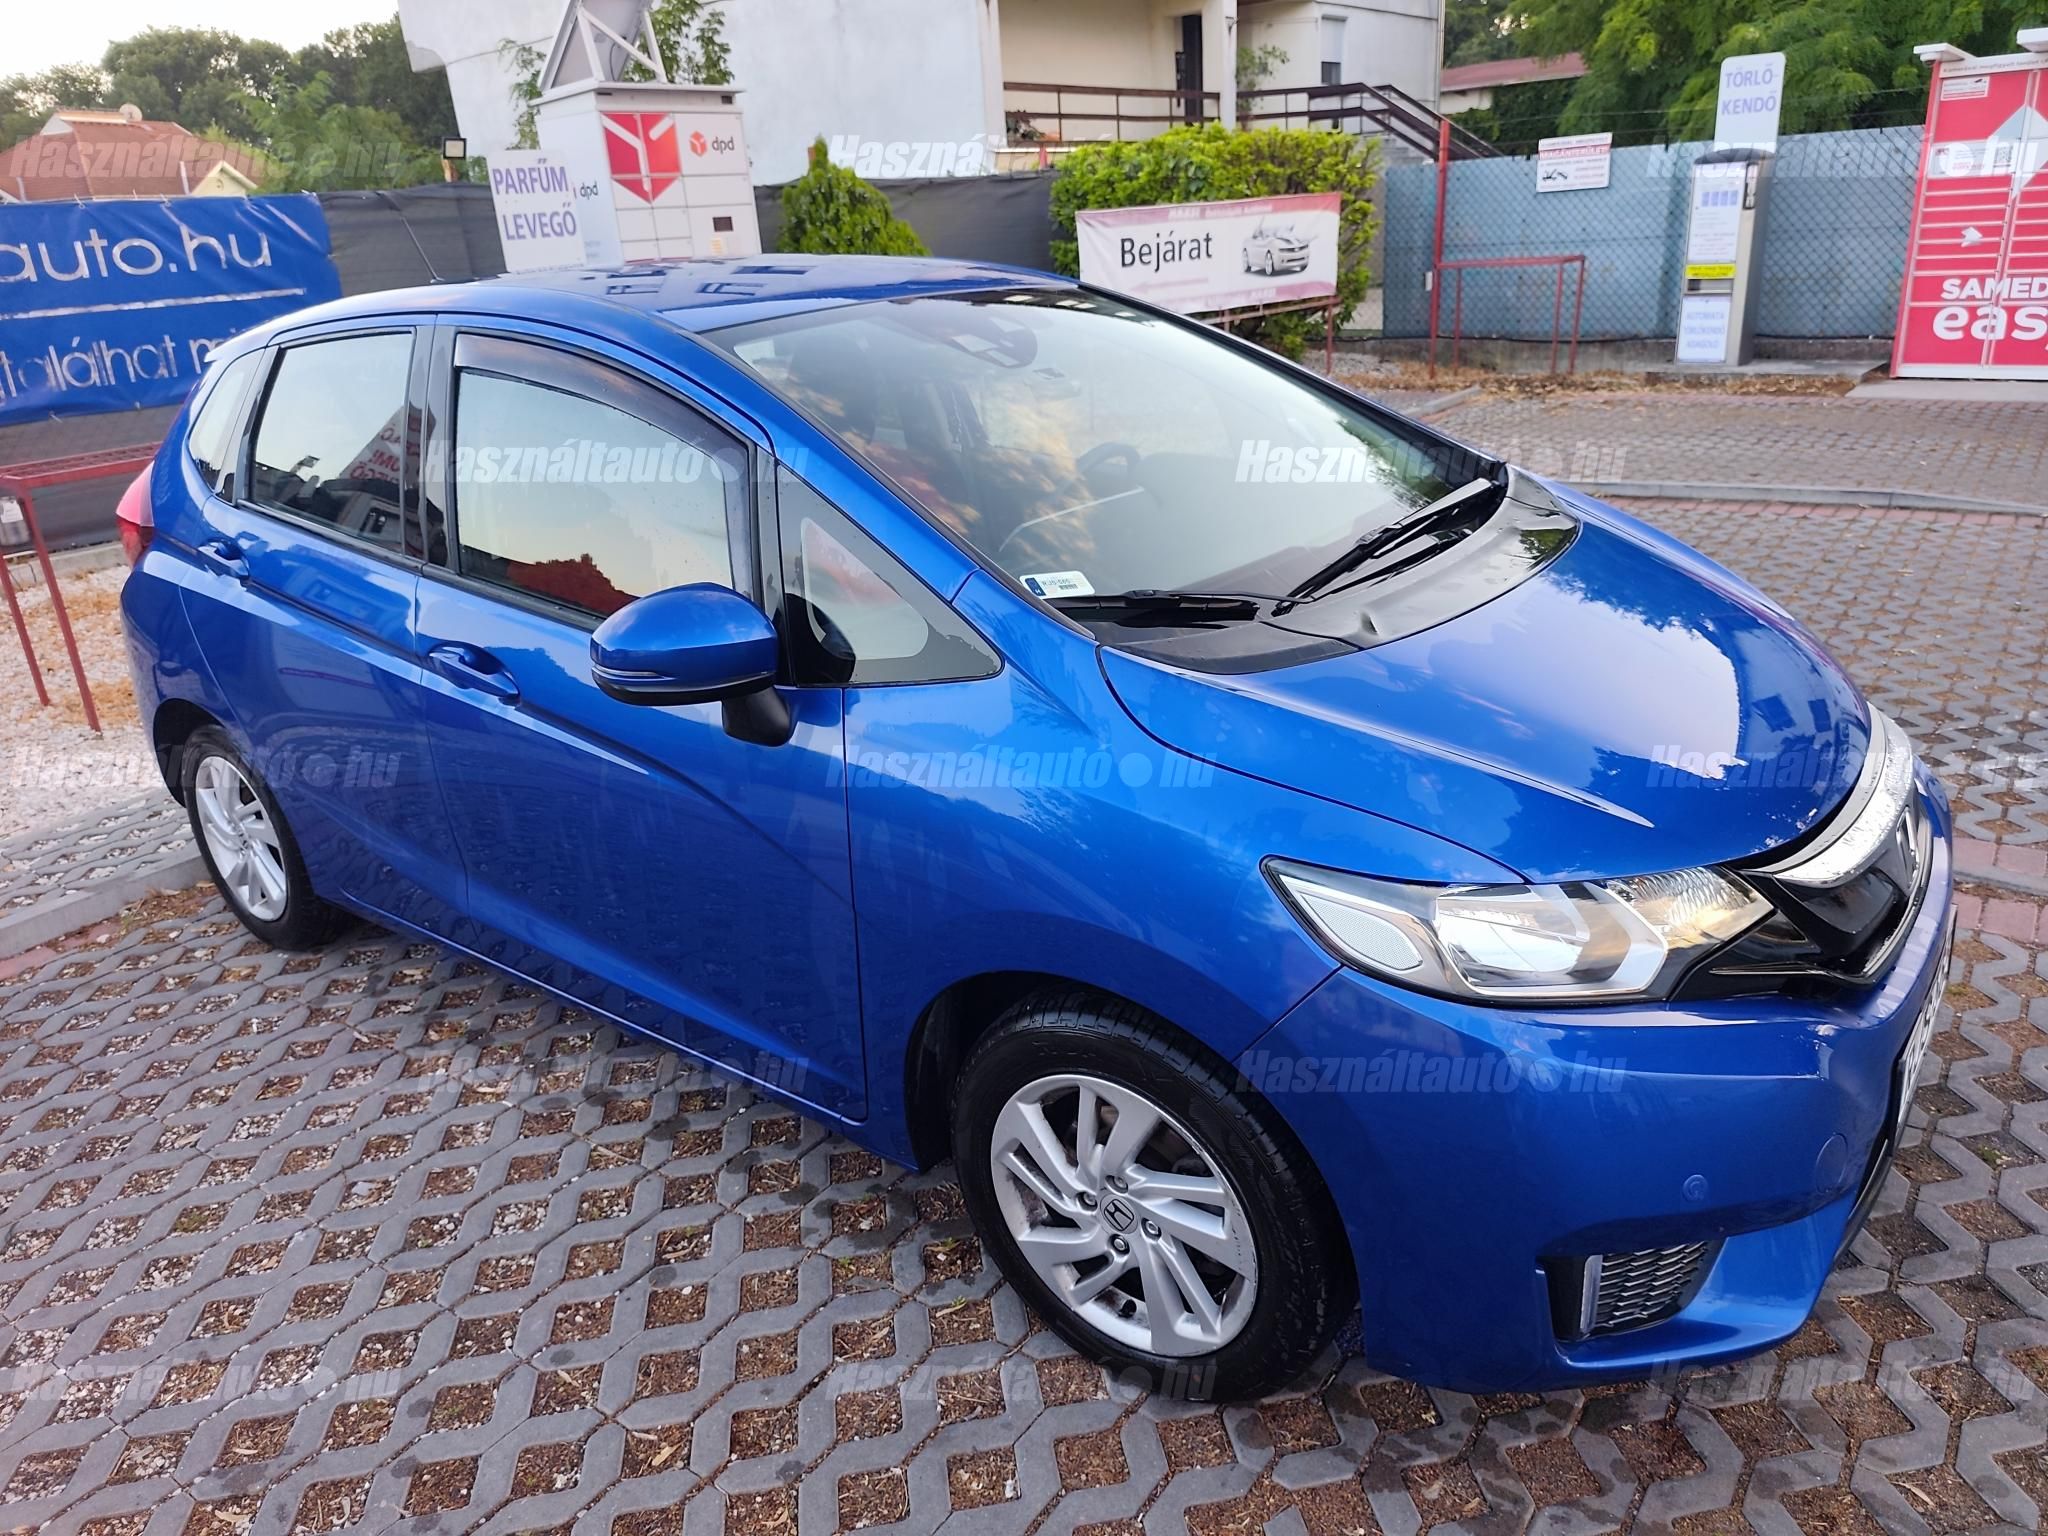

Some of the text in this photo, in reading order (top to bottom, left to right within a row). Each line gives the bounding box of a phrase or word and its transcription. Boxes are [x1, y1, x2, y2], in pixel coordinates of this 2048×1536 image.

[1721, 90, 1778, 115] KENDŐ
[711, 136, 735, 154] dpd
[492, 158, 569, 195] PARFŰM
[580, 180, 599, 200] dpd
[502, 201, 576, 240] LEVEGŐ
[1120, 231, 1213, 272] Bejárat
[1932, 306, 2048, 351] eas
[0, 334, 178, 404] találhat
